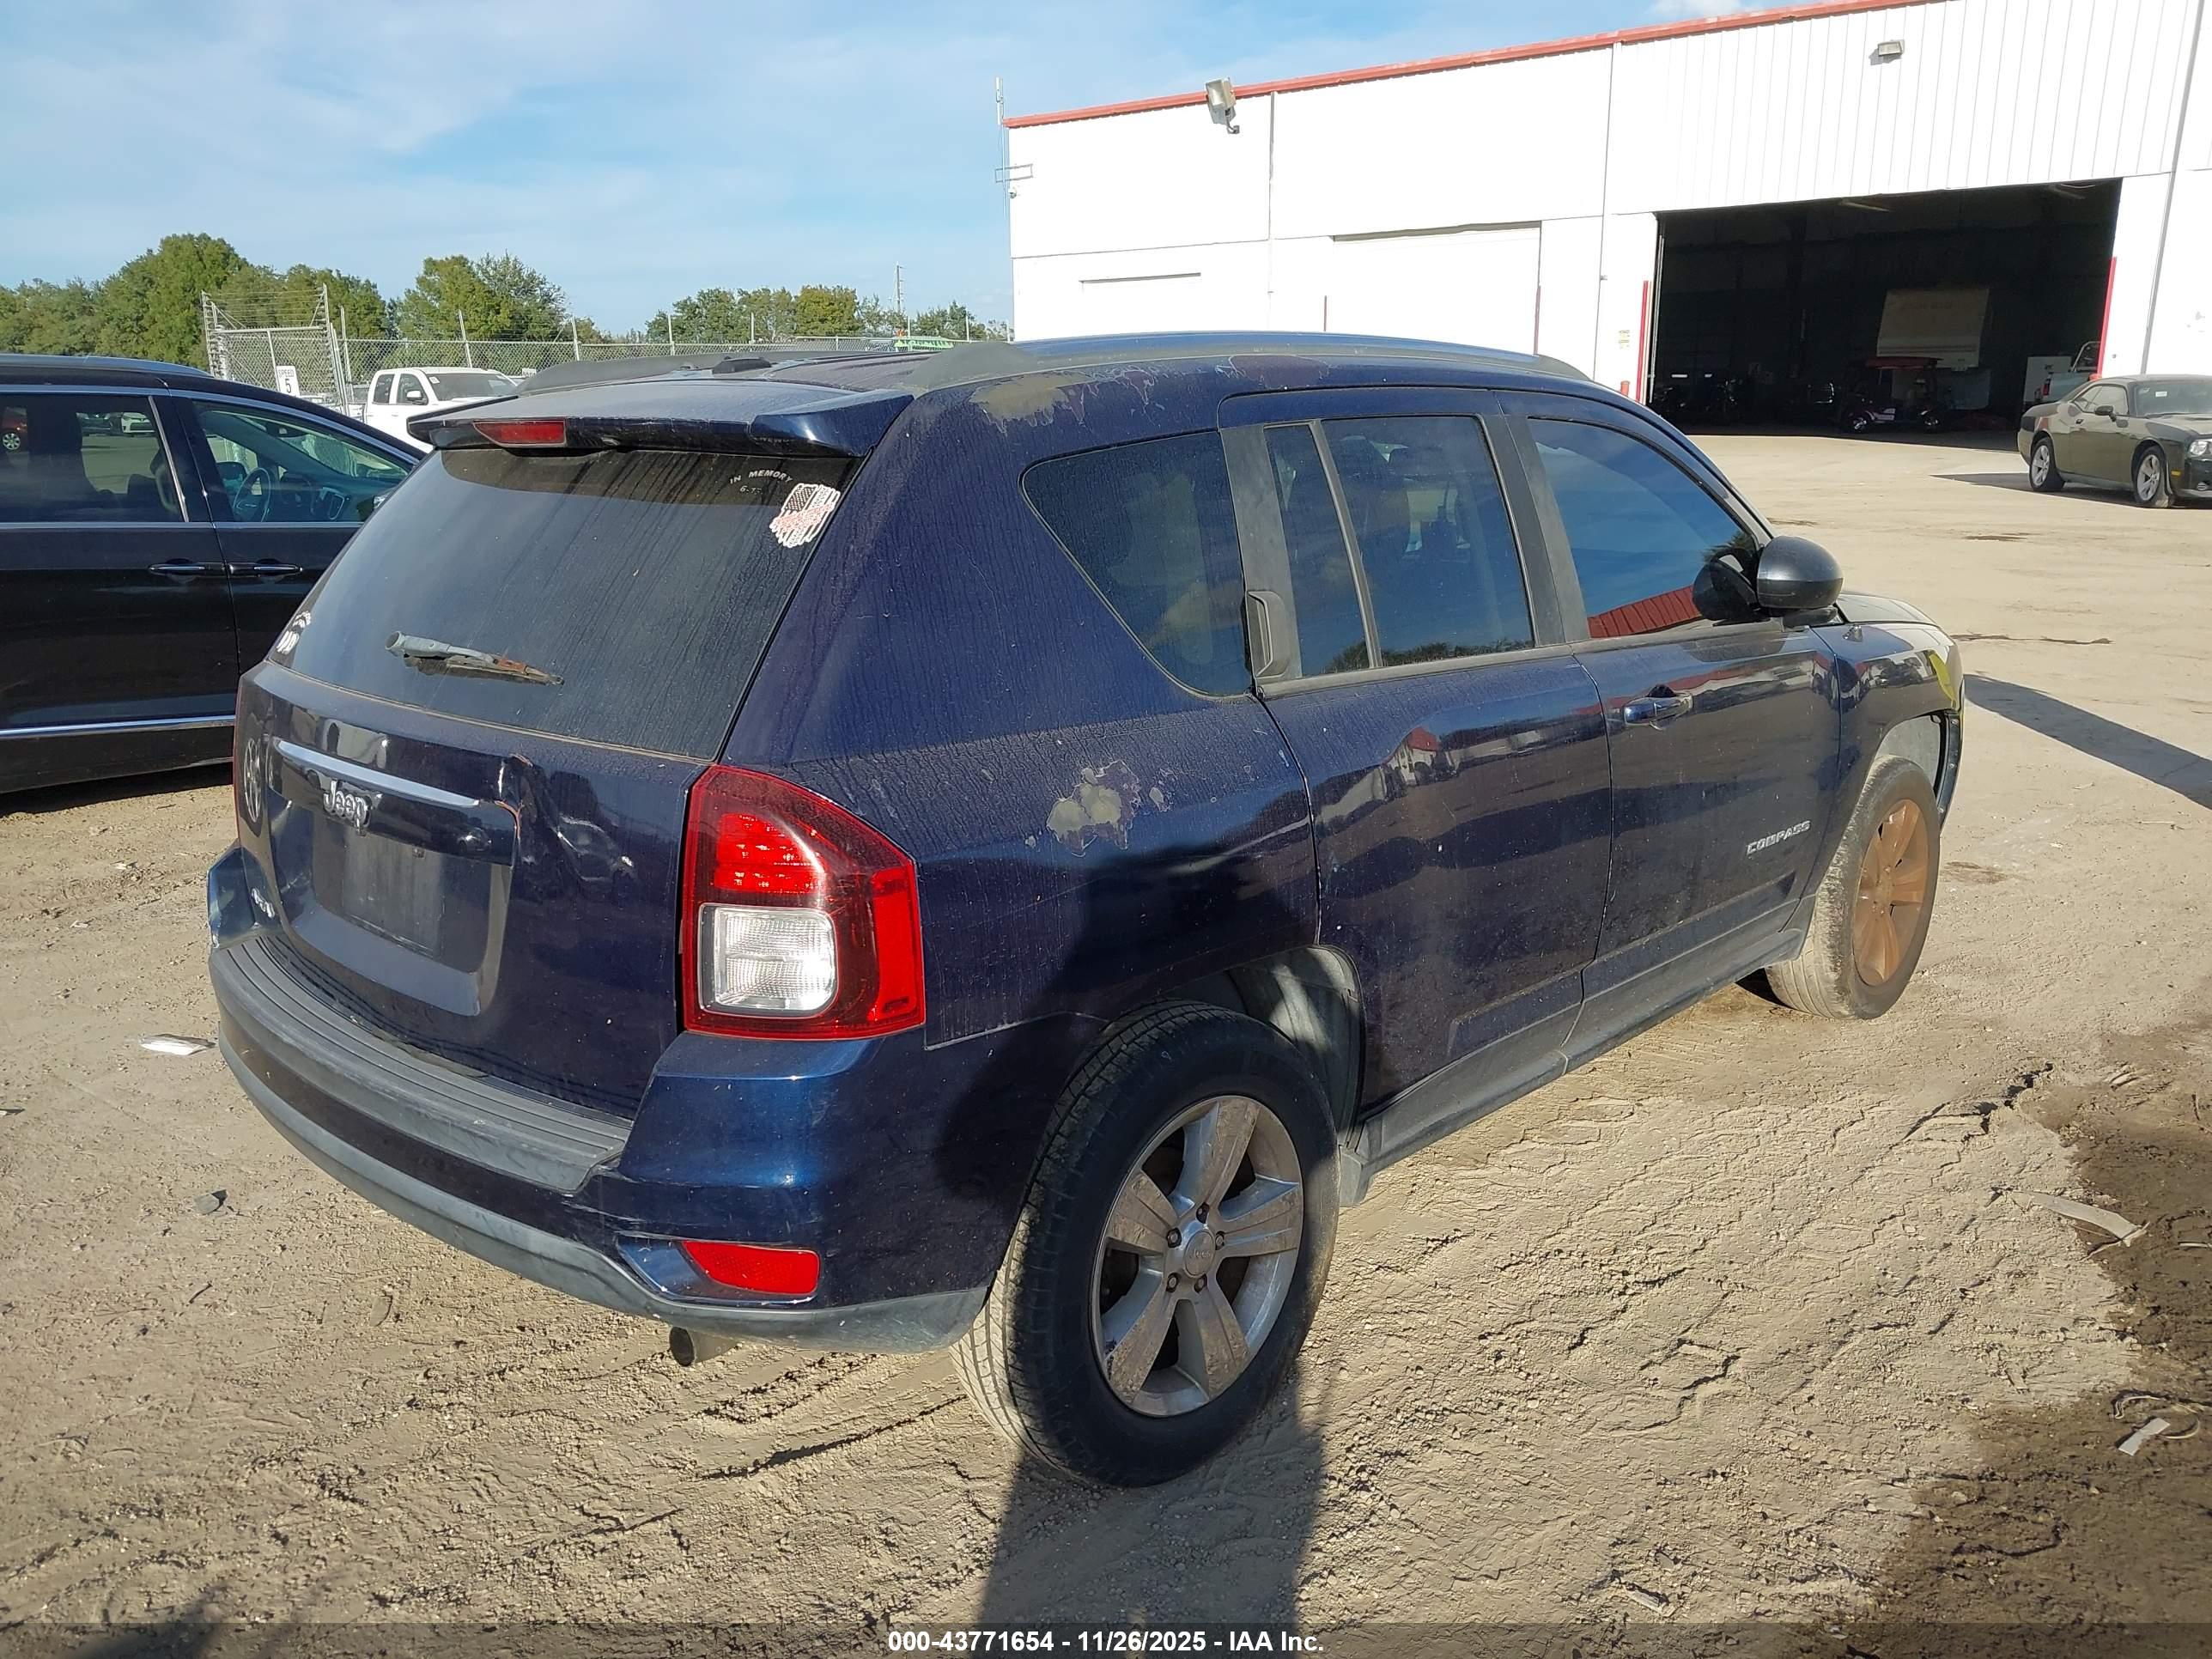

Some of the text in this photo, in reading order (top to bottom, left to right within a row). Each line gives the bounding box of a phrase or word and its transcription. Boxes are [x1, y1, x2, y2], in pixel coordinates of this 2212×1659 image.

[277, 368, 295, 378] SPEED
[284, 378, 292, 393] 5
[729, 469, 793, 484] IN MEMORY
[323, 779, 368, 834] Jeep
[1746, 820, 1812, 856] COMPASS
